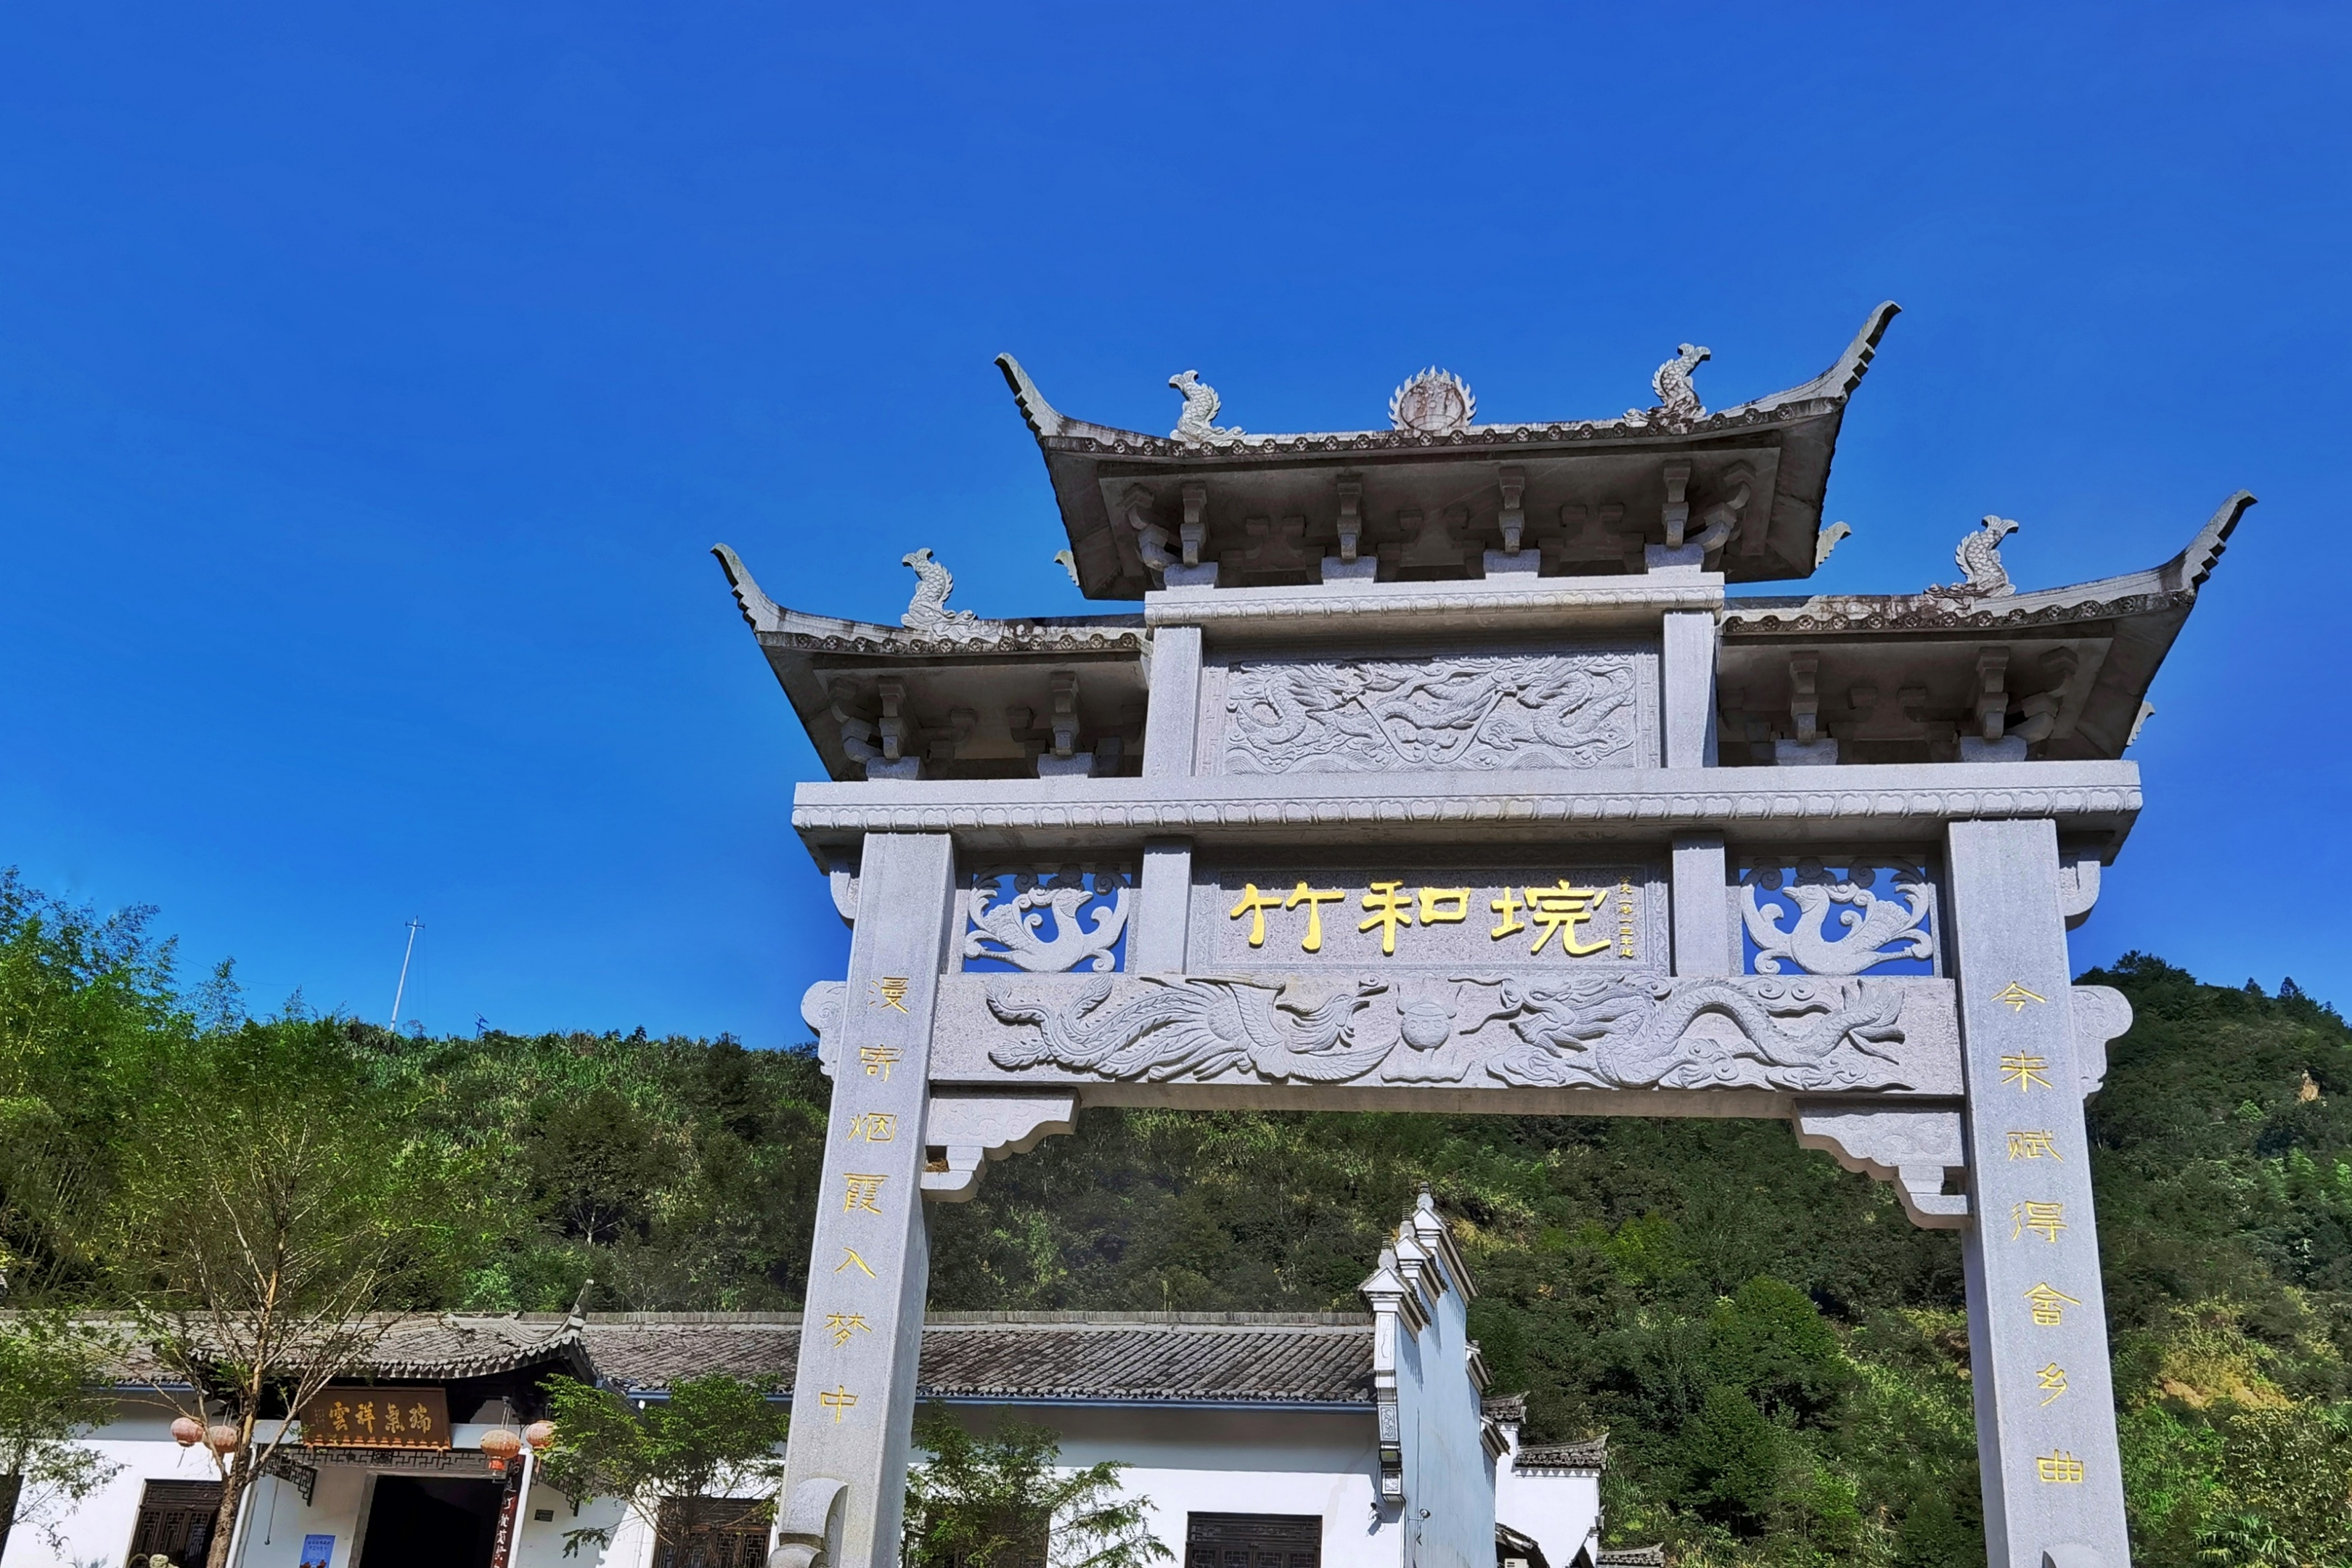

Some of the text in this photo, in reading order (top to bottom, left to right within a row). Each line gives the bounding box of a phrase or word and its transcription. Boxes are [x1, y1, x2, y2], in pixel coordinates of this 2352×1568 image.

[1230, 879, 1612, 956] 竹和垸
[820, 976, 909, 1424] 漫寄烟霞入梦中
